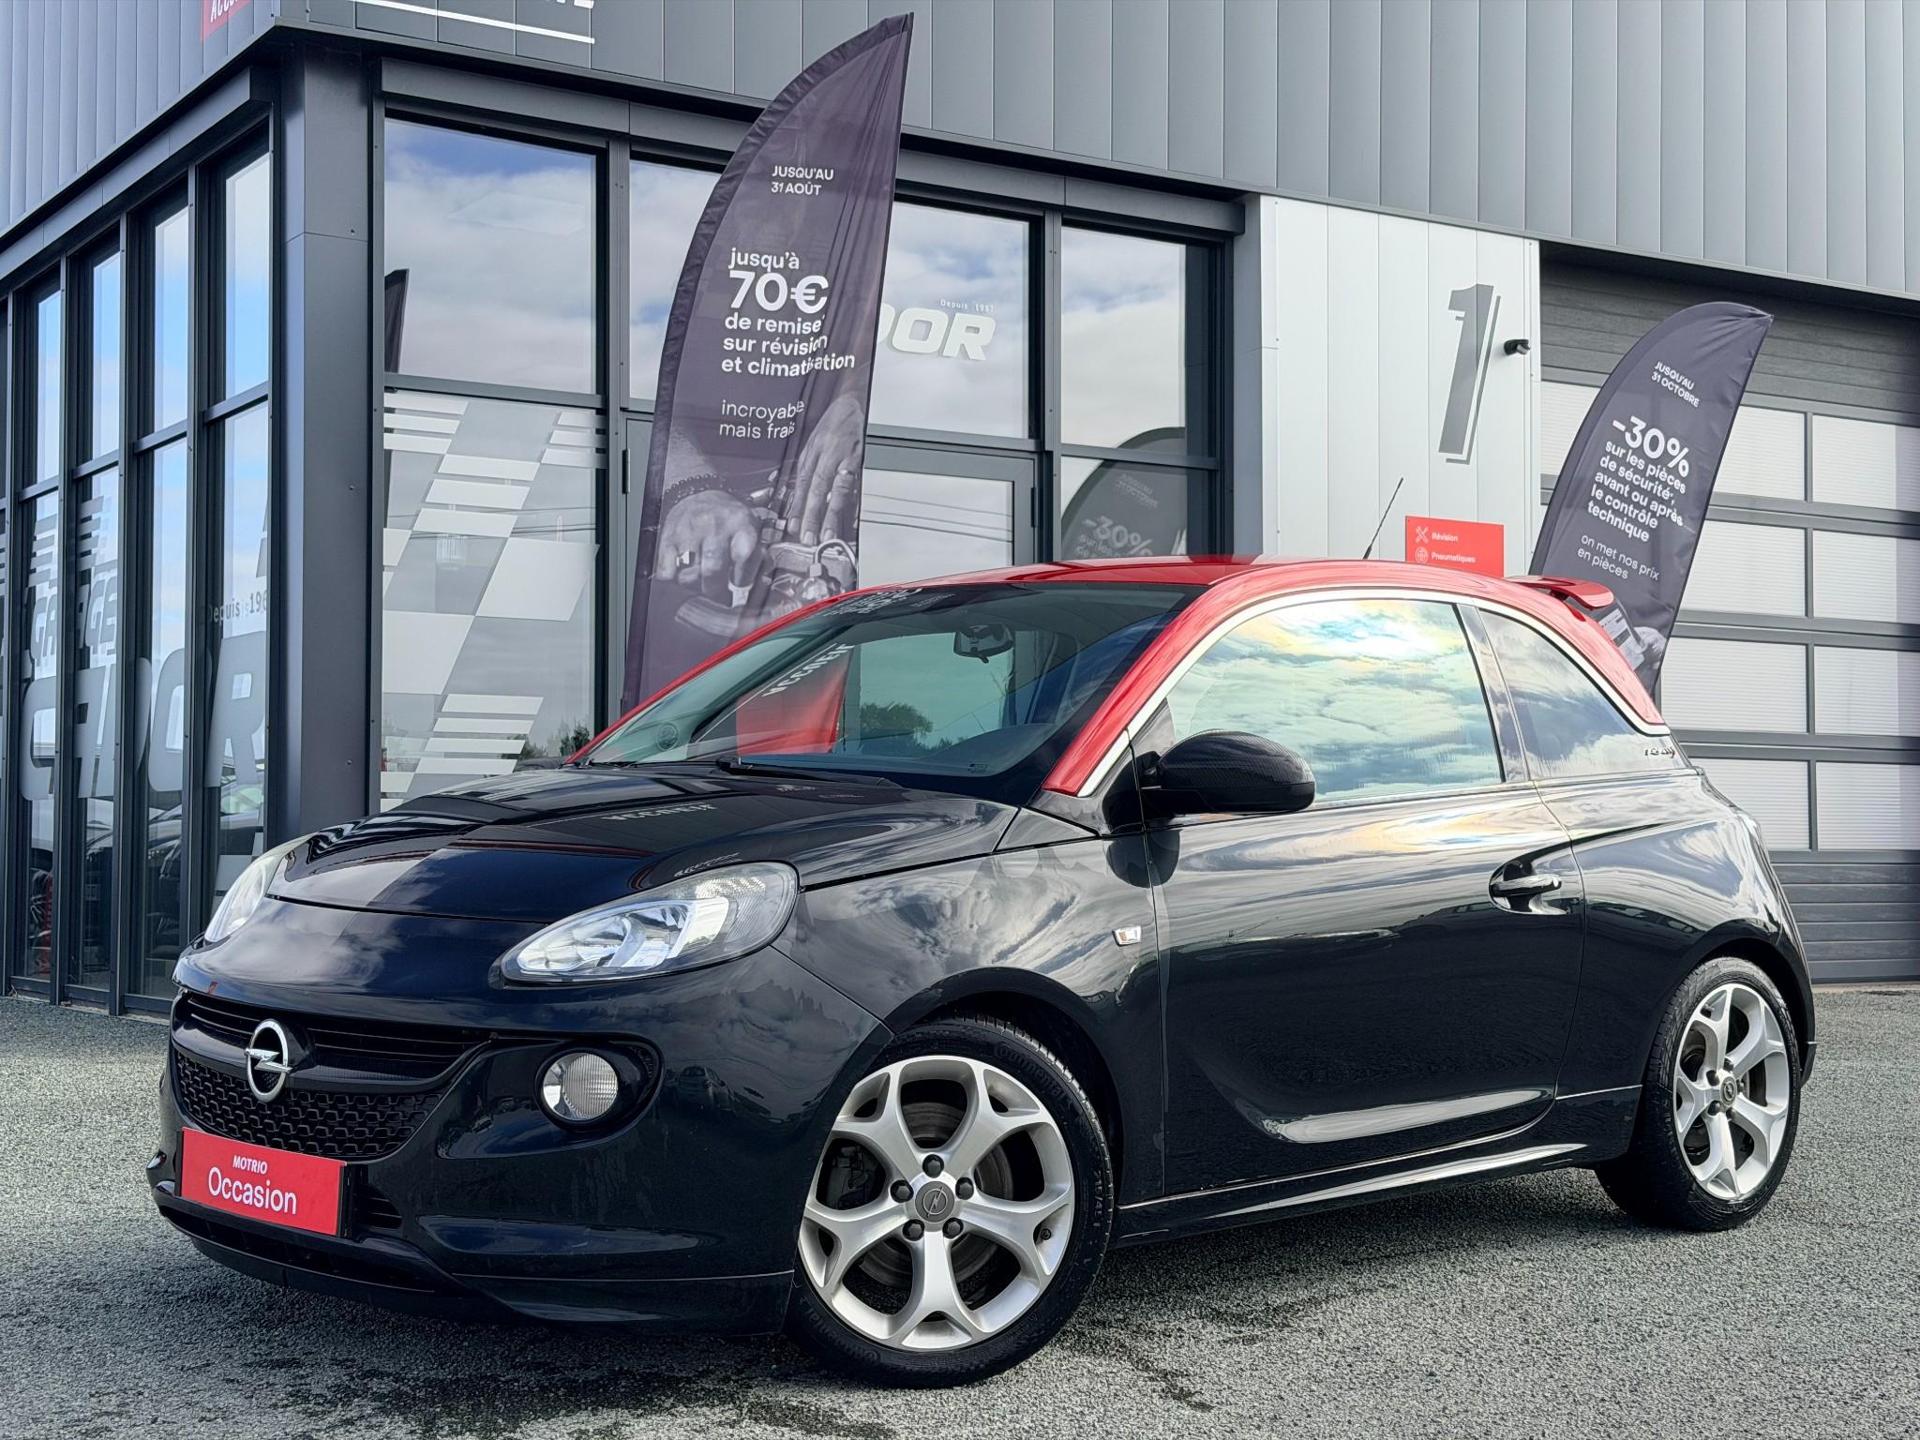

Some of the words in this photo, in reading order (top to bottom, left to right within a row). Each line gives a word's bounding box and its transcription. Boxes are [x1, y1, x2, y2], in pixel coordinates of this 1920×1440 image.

[771, 165, 834, 180] JUSQU'AU
[771, 181, 784, 193] 31
[785, 182, 822, 196] AOÛT
[728, 247, 800, 272] jusqu'à
[728, 269, 829, 314] 70€
[724, 312, 752, 330] de
[723, 337, 756, 352] sur
[721, 357, 743, 373] et
[1438, 283, 1500, 465] 1
[1655, 361, 1695, 390] JUSQU'AU
[1651, 371, 1661, 383] 31
[1660, 378, 1700, 408] OCTOBRE
[721, 400, 805, 423] incroyabe
[719, 422, 761, 439] mais
[1612, 416, 1690, 478] -30%
[1600, 455, 1617, 471] de
[1605, 441, 1626, 458] sur
[1626, 448, 1646, 470] les
[1646, 463, 1686, 494] pièces
[1591, 483, 1604, 500] le
[1604, 494, 1659, 529] contrôle
[1595, 471, 1630, 497] avant
[1631, 491, 1648, 507] ou
[1650, 501, 1684, 527] après
[1587, 500, 1650, 542] technique
[1577, 548, 1591, 561] en
[1591, 555, 1629, 580] pièces
[1581, 535, 1595, 548] on
[1596, 542, 1618, 559] met
[1618, 553, 1638, 570] nos
[1638, 565, 1660, 581] prix
[232, 1154, 268, 1175] MOTRIO
[208, 1166, 297, 1215] Occasion
